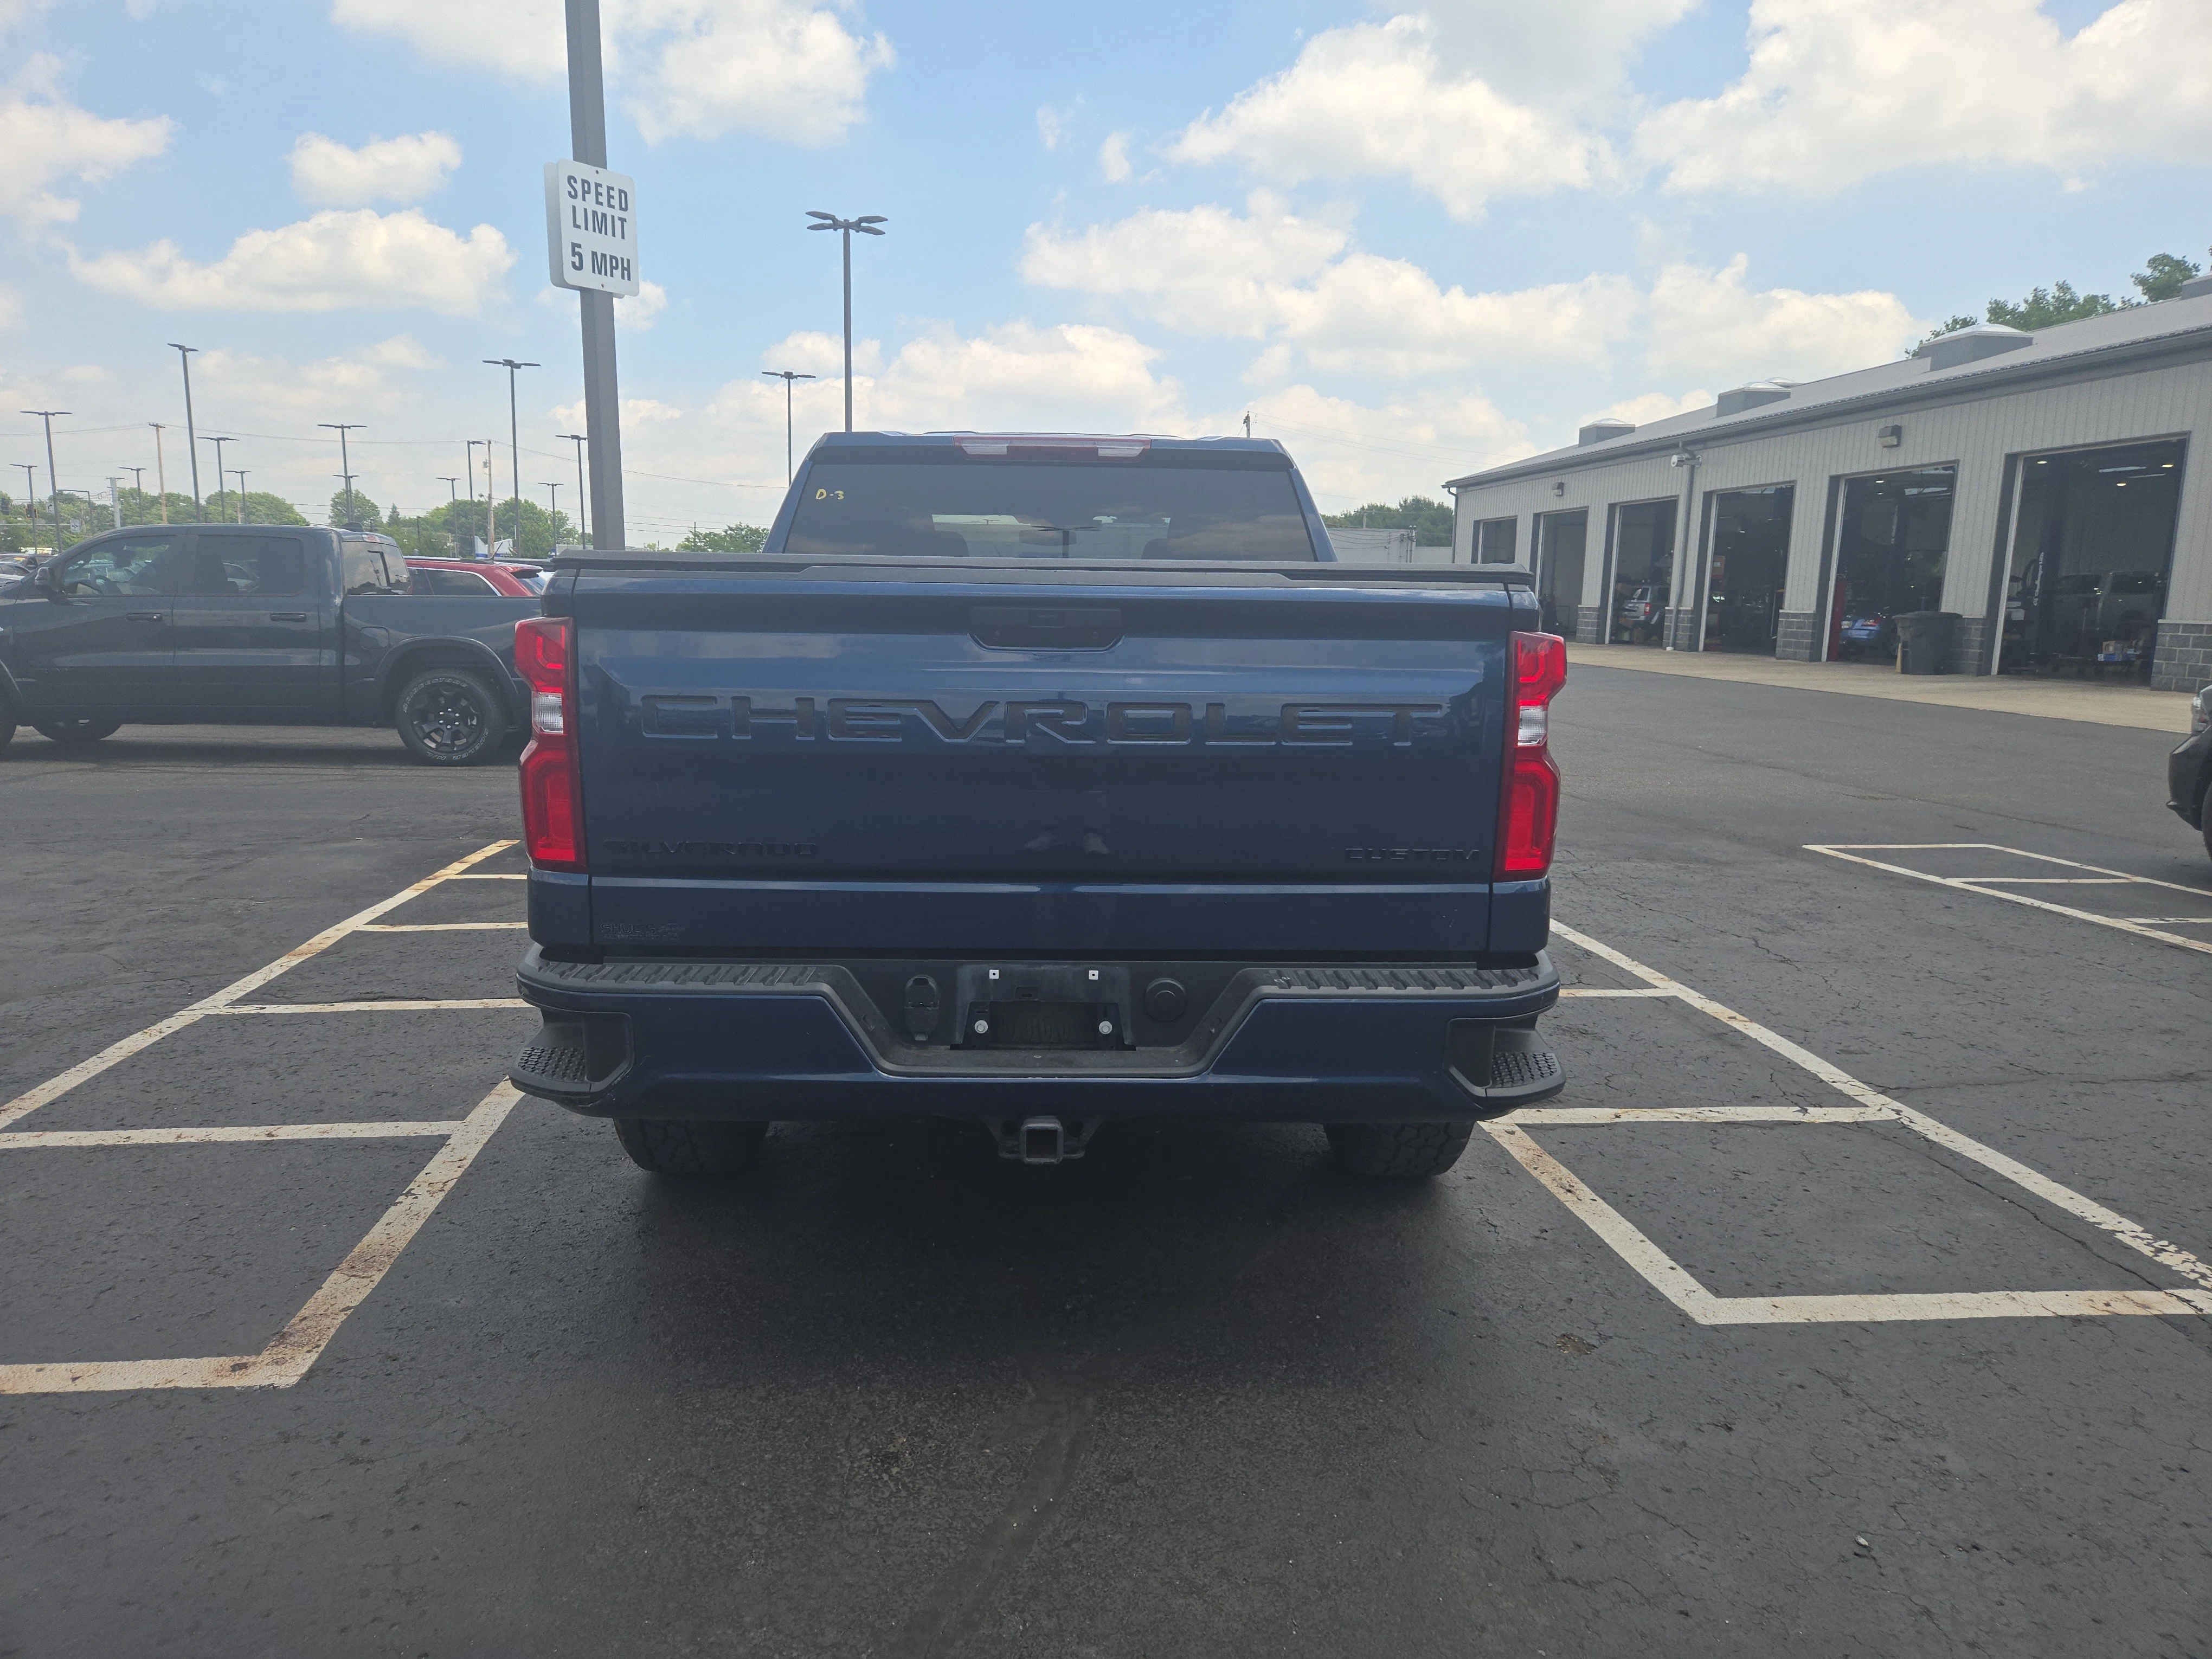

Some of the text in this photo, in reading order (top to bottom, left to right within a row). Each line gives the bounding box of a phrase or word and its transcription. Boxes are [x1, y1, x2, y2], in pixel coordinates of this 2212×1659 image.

[567, 175, 628, 212] SPEED
[571, 204, 627, 240] LIMIT
[570, 241, 631, 281] 5 MPH
[641, 695, 1441, 747] CHEVROLET
[1346, 847, 1481, 861] CUSTOM
